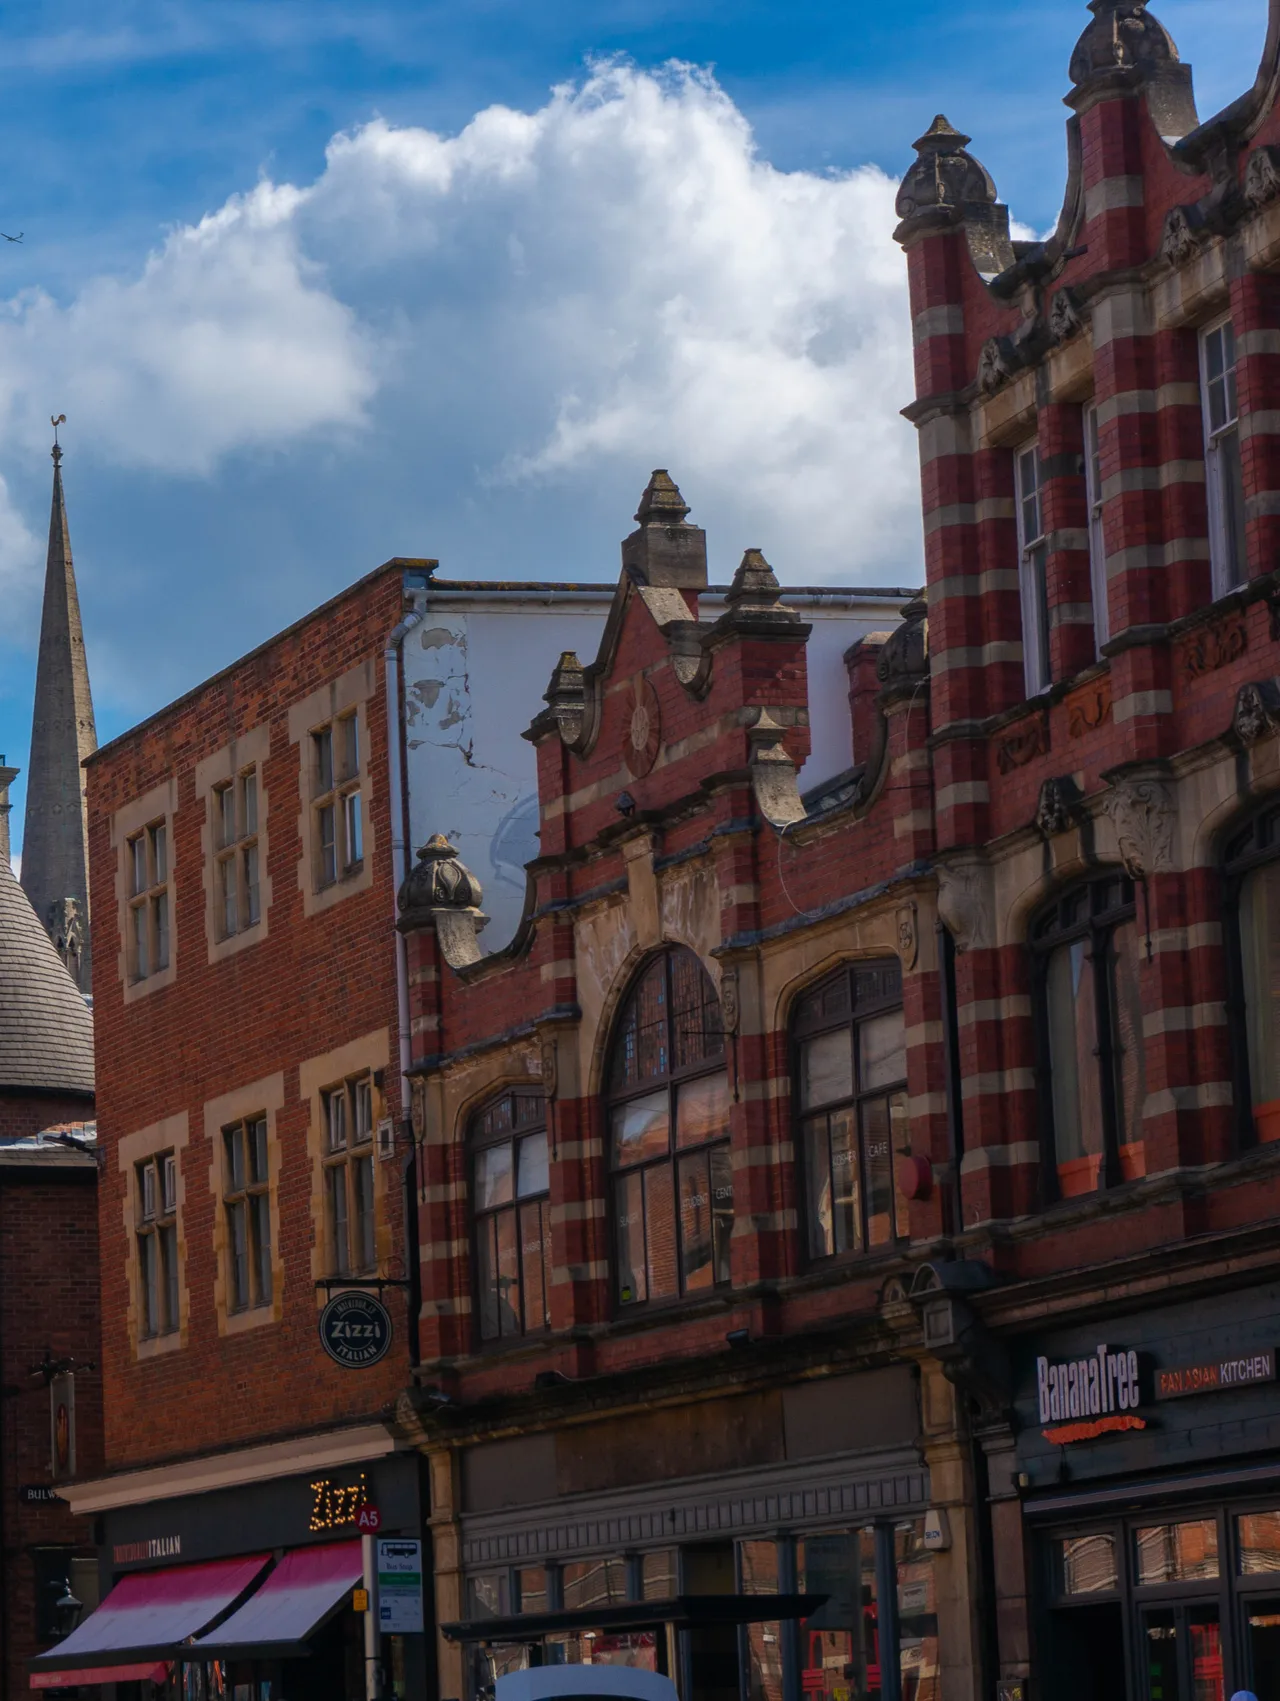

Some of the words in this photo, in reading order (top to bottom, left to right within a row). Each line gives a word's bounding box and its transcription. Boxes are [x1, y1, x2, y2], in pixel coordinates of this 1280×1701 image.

[331, 1320, 381, 1339] Zizzi
[336, 1344, 378, 1361] ITALIAN
[1161, 1371, 1183, 1394] PAN
[1186, 1364, 1218, 1389] ASIAN
[1220, 1355, 1271, 1384] KITCHEN
[27, 1488, 58, 1500] BULW
[358, 1510, 379, 1527] A5
[148, 1535, 181, 1559] ITALIAN
[386, 1562, 398, 1571] Bus
[399, 1562, 413, 1572] Stop
